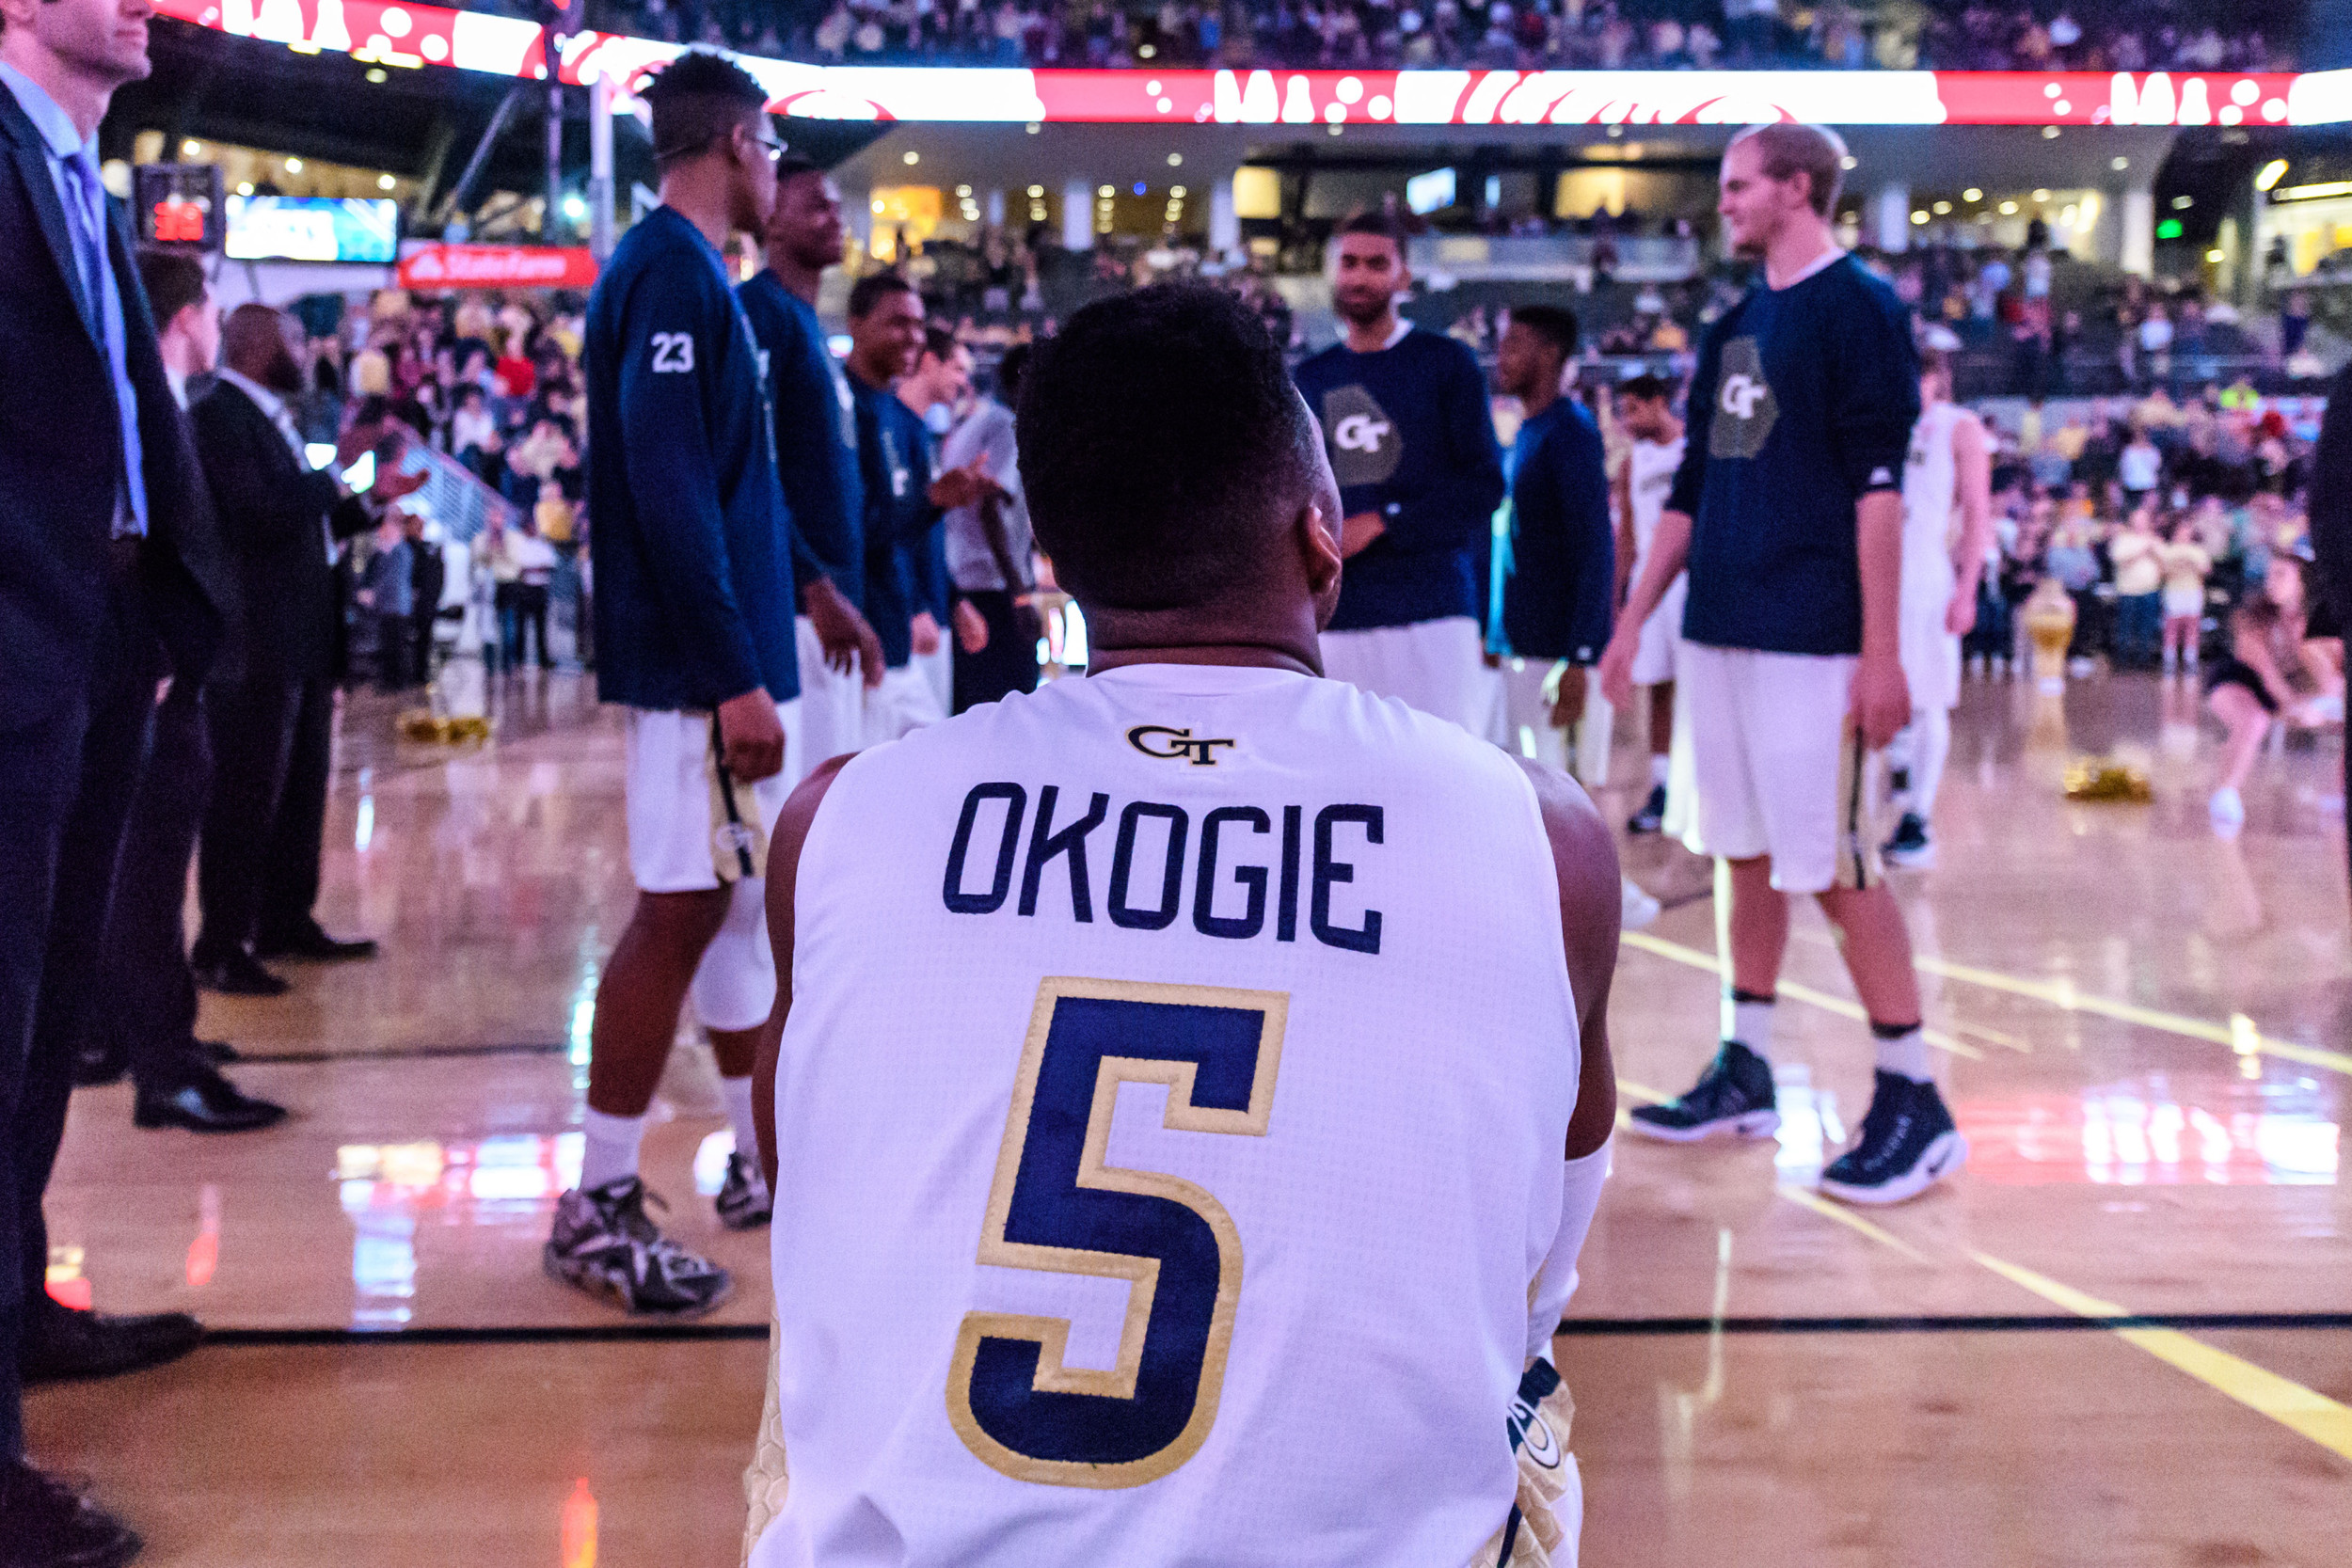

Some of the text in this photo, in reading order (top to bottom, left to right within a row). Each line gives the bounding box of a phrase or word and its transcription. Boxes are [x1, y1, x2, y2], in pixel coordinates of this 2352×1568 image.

[651, 331, 694, 373] 23
[1721, 373, 1767, 420] GT
[1335, 414, 1391, 452] GT
[1125, 725, 1236, 767] GT
[943, 782, 1385, 955] OKOGIE
[945, 975, 1291, 1490] 5
